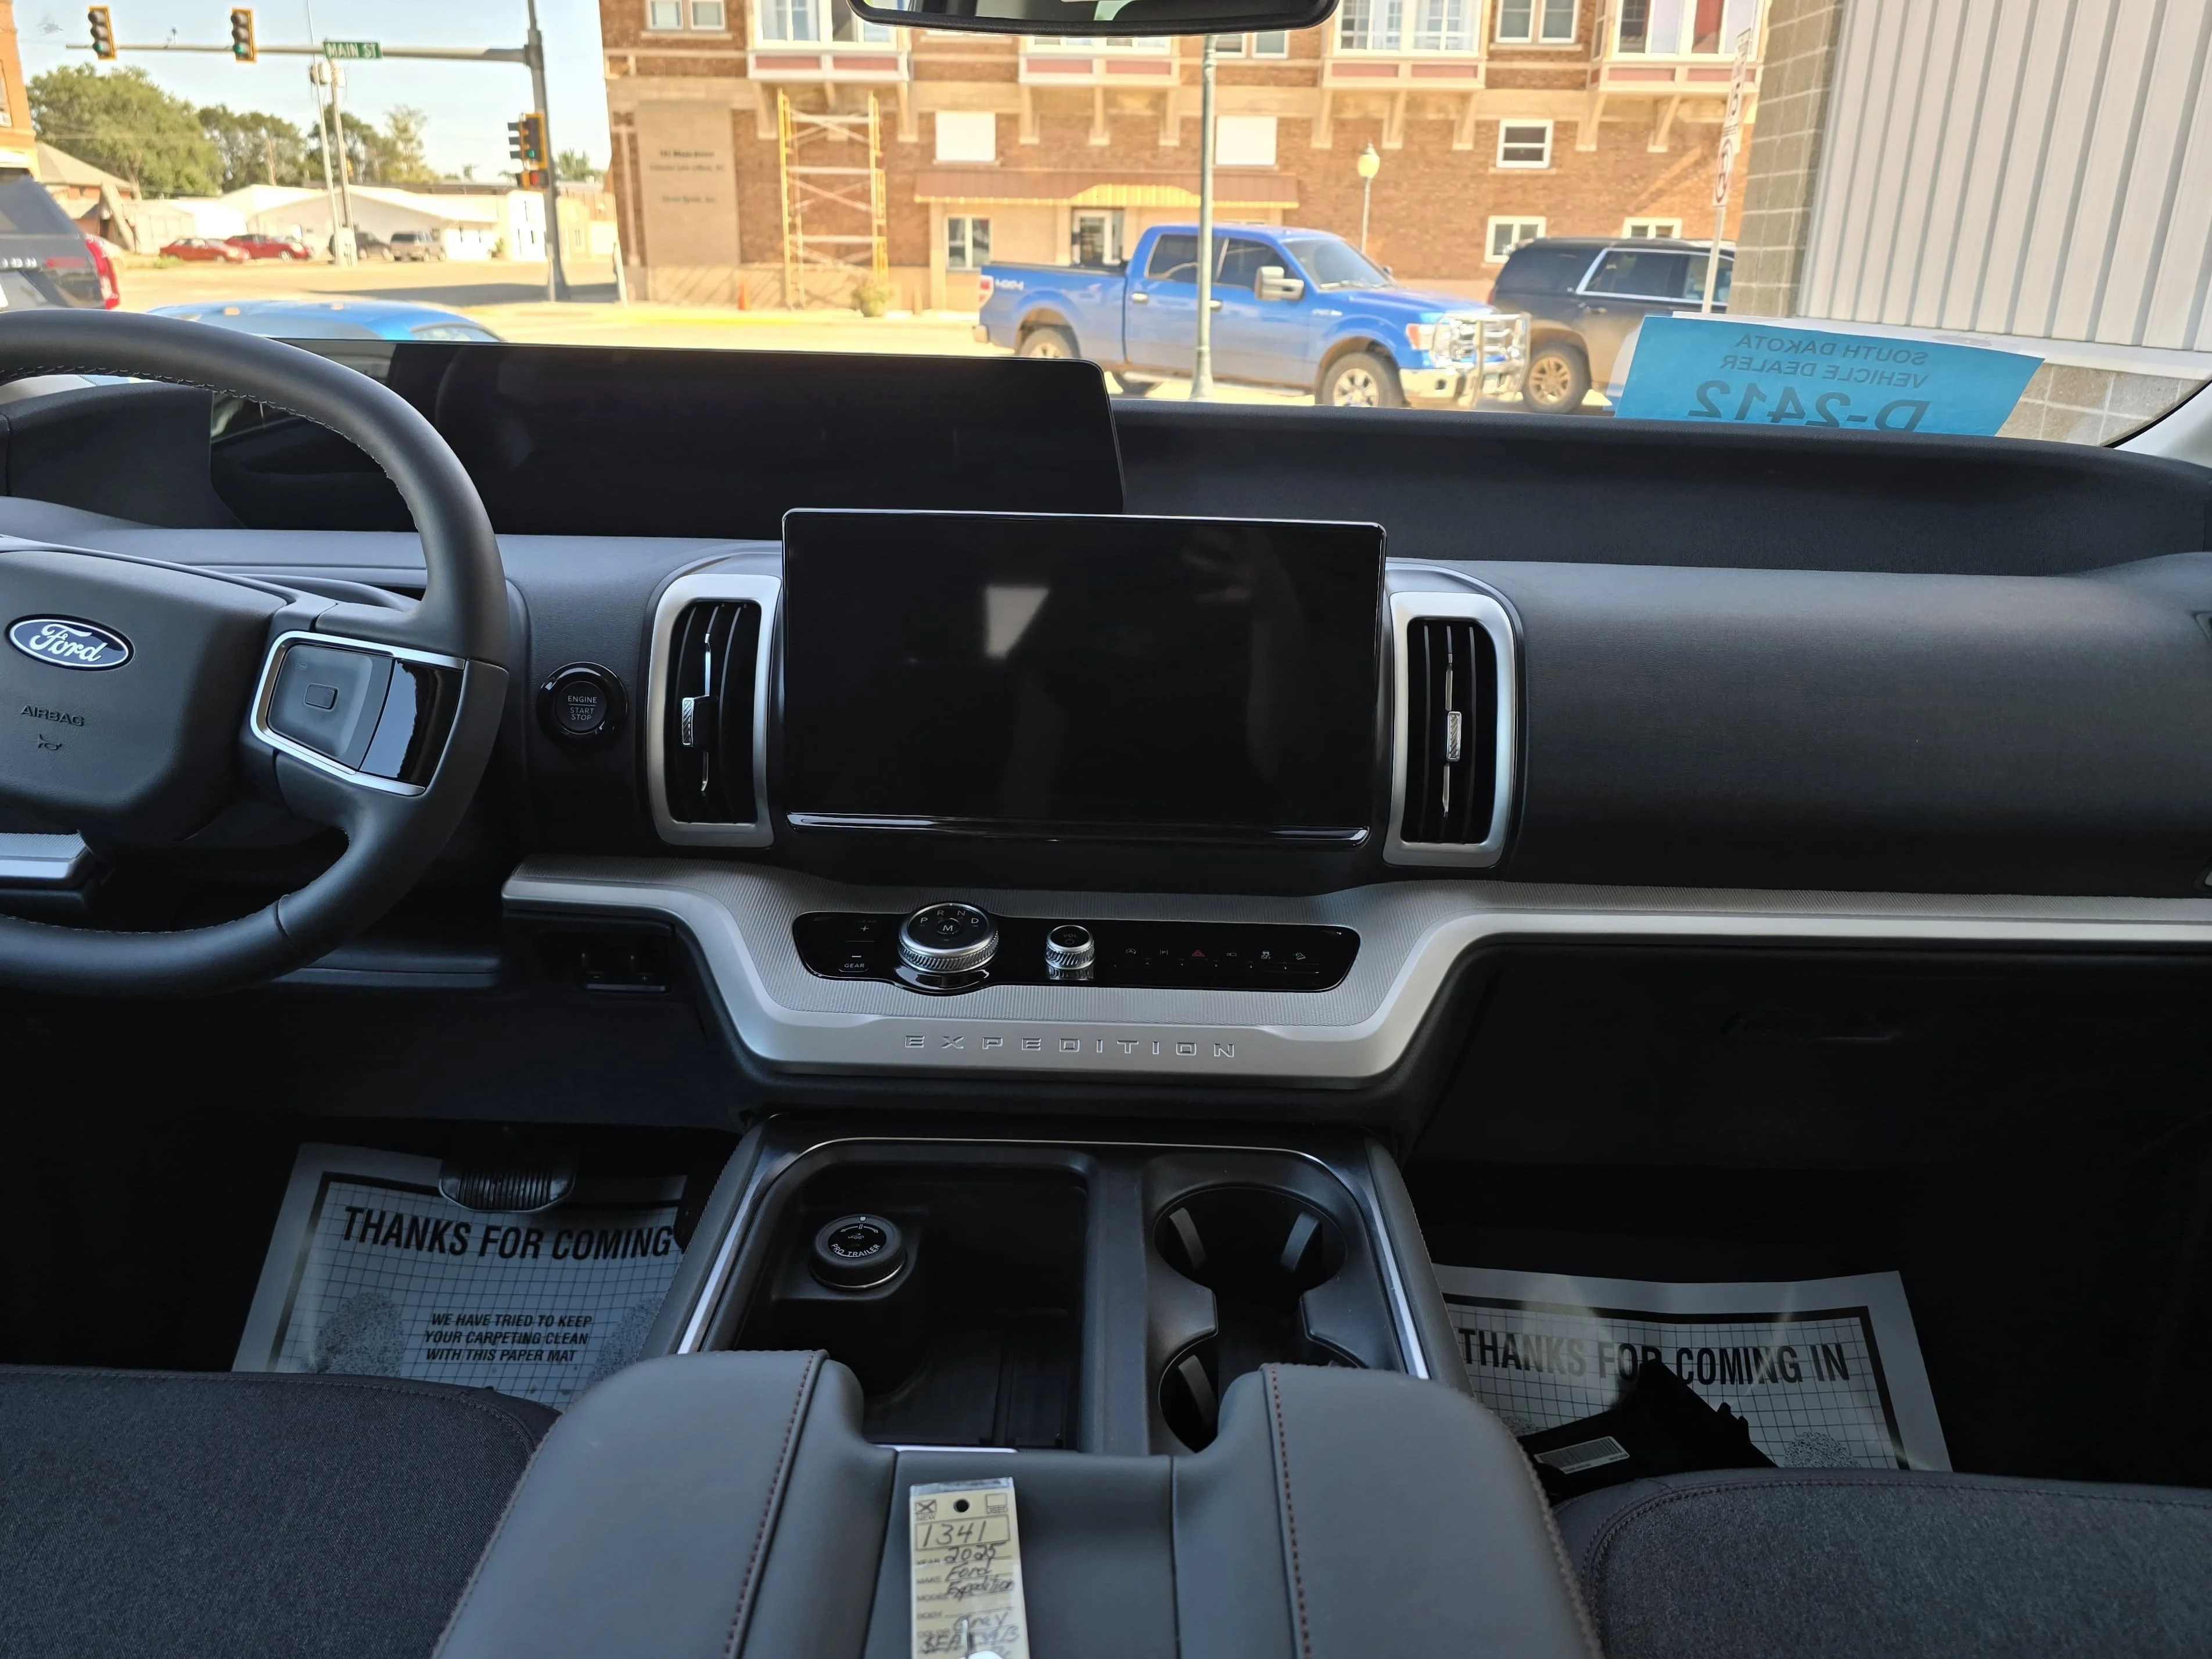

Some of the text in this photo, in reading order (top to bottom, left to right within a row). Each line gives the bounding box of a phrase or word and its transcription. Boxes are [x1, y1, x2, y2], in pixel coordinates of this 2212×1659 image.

[327, 42, 376, 58] MAIN ST
[30, 623, 109, 662] Ford
[568, 695, 597, 703] ENGINE
[20, 705, 85, 727] AIRBAG
[904, 1035, 1235, 1057] EXPEDITION
[343, 1206, 674, 1260] THANKS FOR COMING
[831, 1243, 881, 1257] PRO TRAILER
[432, 1313, 592, 1327] WE HAVE TRIED TO KEEP
[425, 1330, 589, 1345] YOUR CARPETING CLEAN
[426, 1348, 578, 1362] WITH THIS PAPER MAT
[1459, 1328, 1586, 1377] THANKS
[1676, 1345, 1803, 1385] COMING
[1811, 1343, 1851, 1381] IN
[923, 1520, 986, 1547] 1341
[945, 1542, 1007, 1563] 2025
[945, 1560, 993, 1582] Ford
